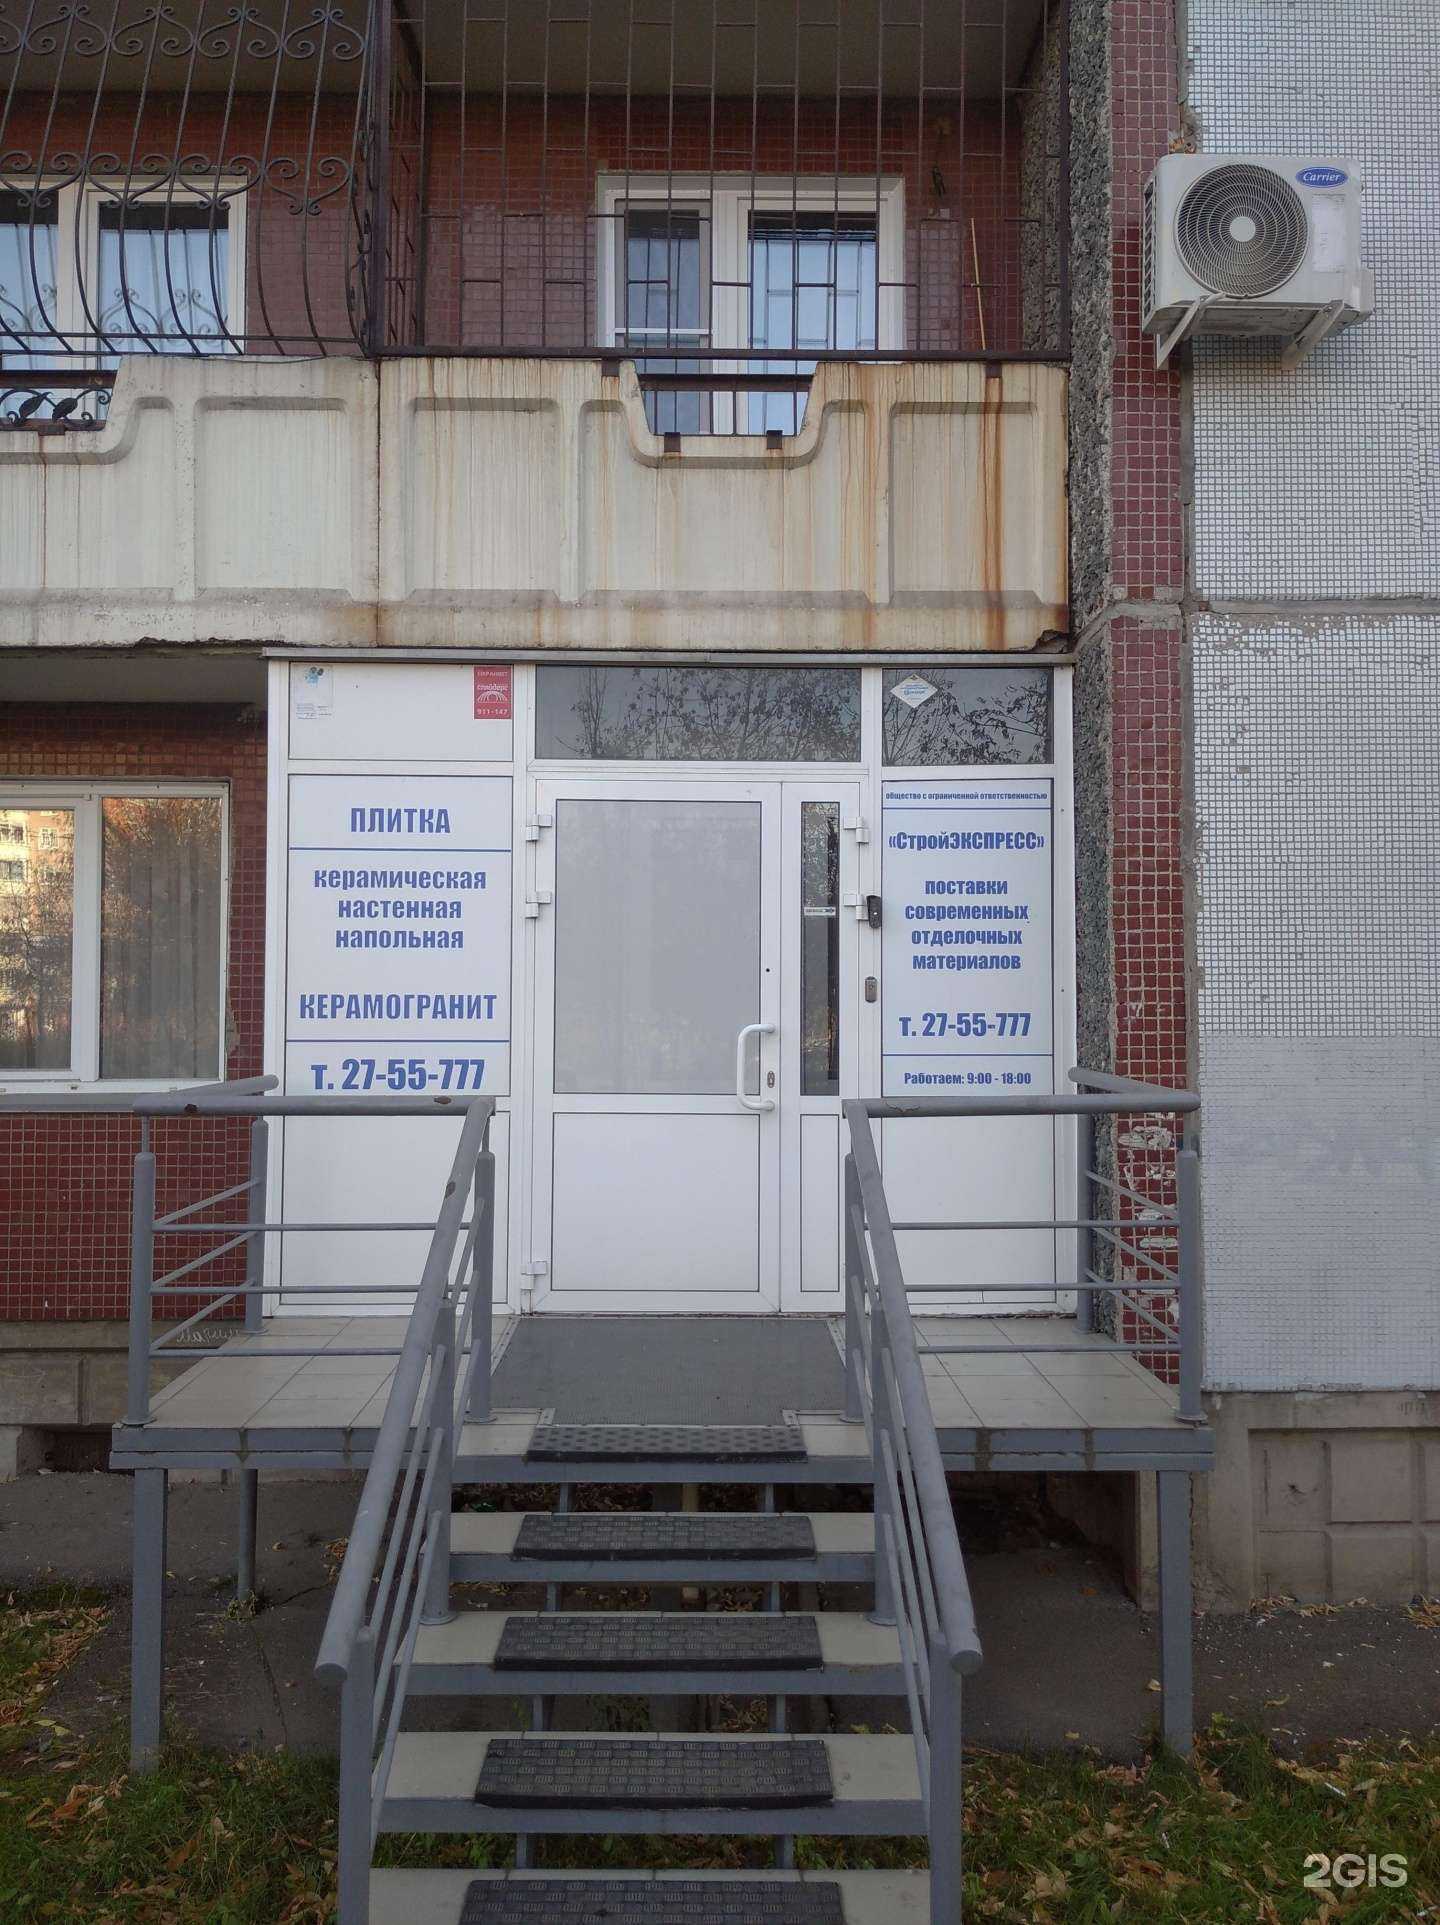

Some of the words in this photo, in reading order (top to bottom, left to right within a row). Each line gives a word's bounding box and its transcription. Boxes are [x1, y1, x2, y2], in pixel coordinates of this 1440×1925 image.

[1303, 172, 1341, 182] Carrier
[886, 792, 922, 800] общество
[928, 792, 979, 800] ограниченной
[350, 807, 451, 833] ПЛИТКА
[888, 831, 1045, 851] «СтройЭКСПРЕСС»
[313, 869, 487, 890] керамическая
[925, 880, 1008, 895] поставки
[338, 900, 462, 919] настенная
[905, 905, 1028, 921] современных
[335, 929, 464, 949] напольная
[911, 930, 1022, 947] отделочных
[912, 955, 1021, 971] материалов
[299, 994, 497, 1020] КЕРАМОГРАНИТ
[899, 1014, 917, 1037] т.
[922, 1012, 1032, 1038] 27-55-777
[311, 1063, 335, 1091] т.
[341, 1058, 486, 1091] 27-55-777
[904, 1072, 965, 1085] Работаем:
[967, 1072, 992, 1085] 9:00
[1001, 1072, 1032, 1085] 18:00
